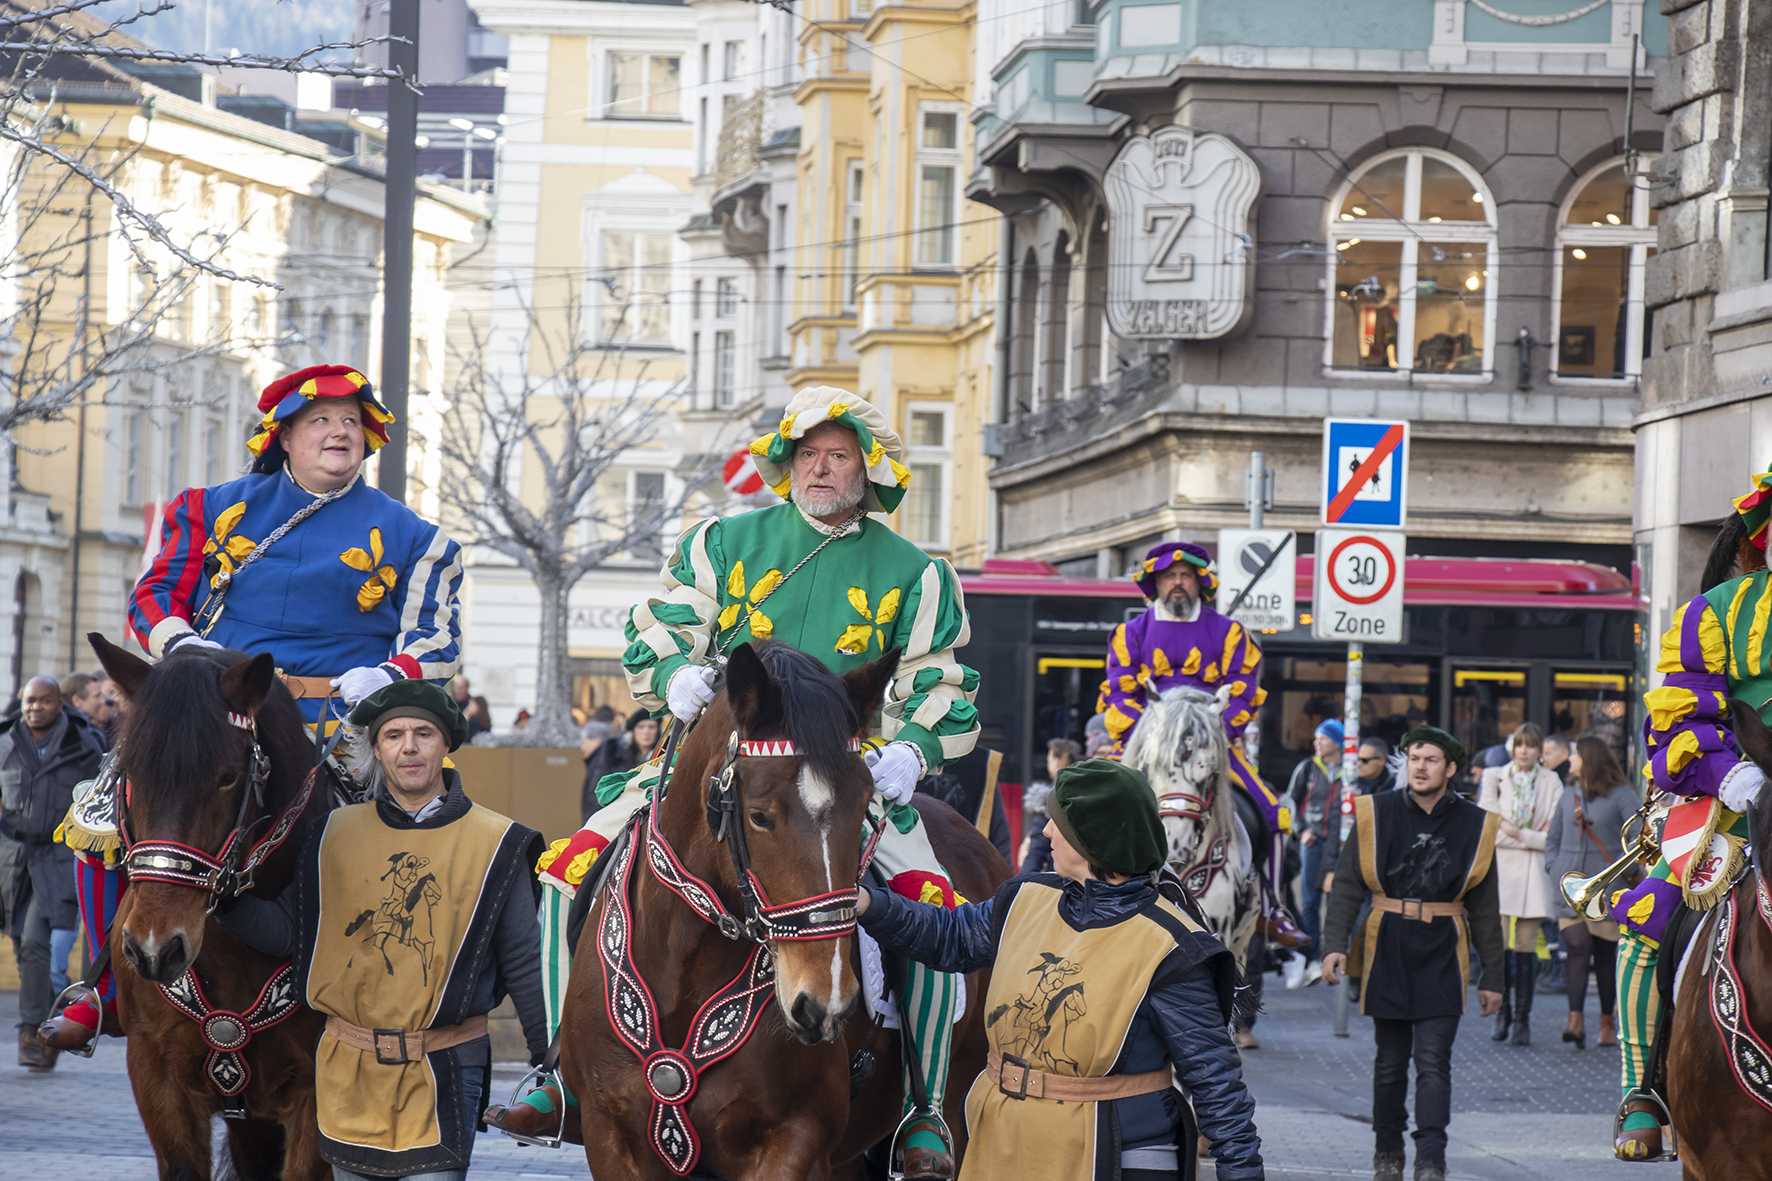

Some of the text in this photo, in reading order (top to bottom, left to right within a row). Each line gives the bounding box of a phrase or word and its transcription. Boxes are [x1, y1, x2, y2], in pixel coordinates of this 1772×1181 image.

[1142, 203, 1194, 283] Z
[1129, 300, 1209, 334] ZELGER
[1348, 556, 1376, 586] 30
[1334, 611, 1386, 634] Zone
